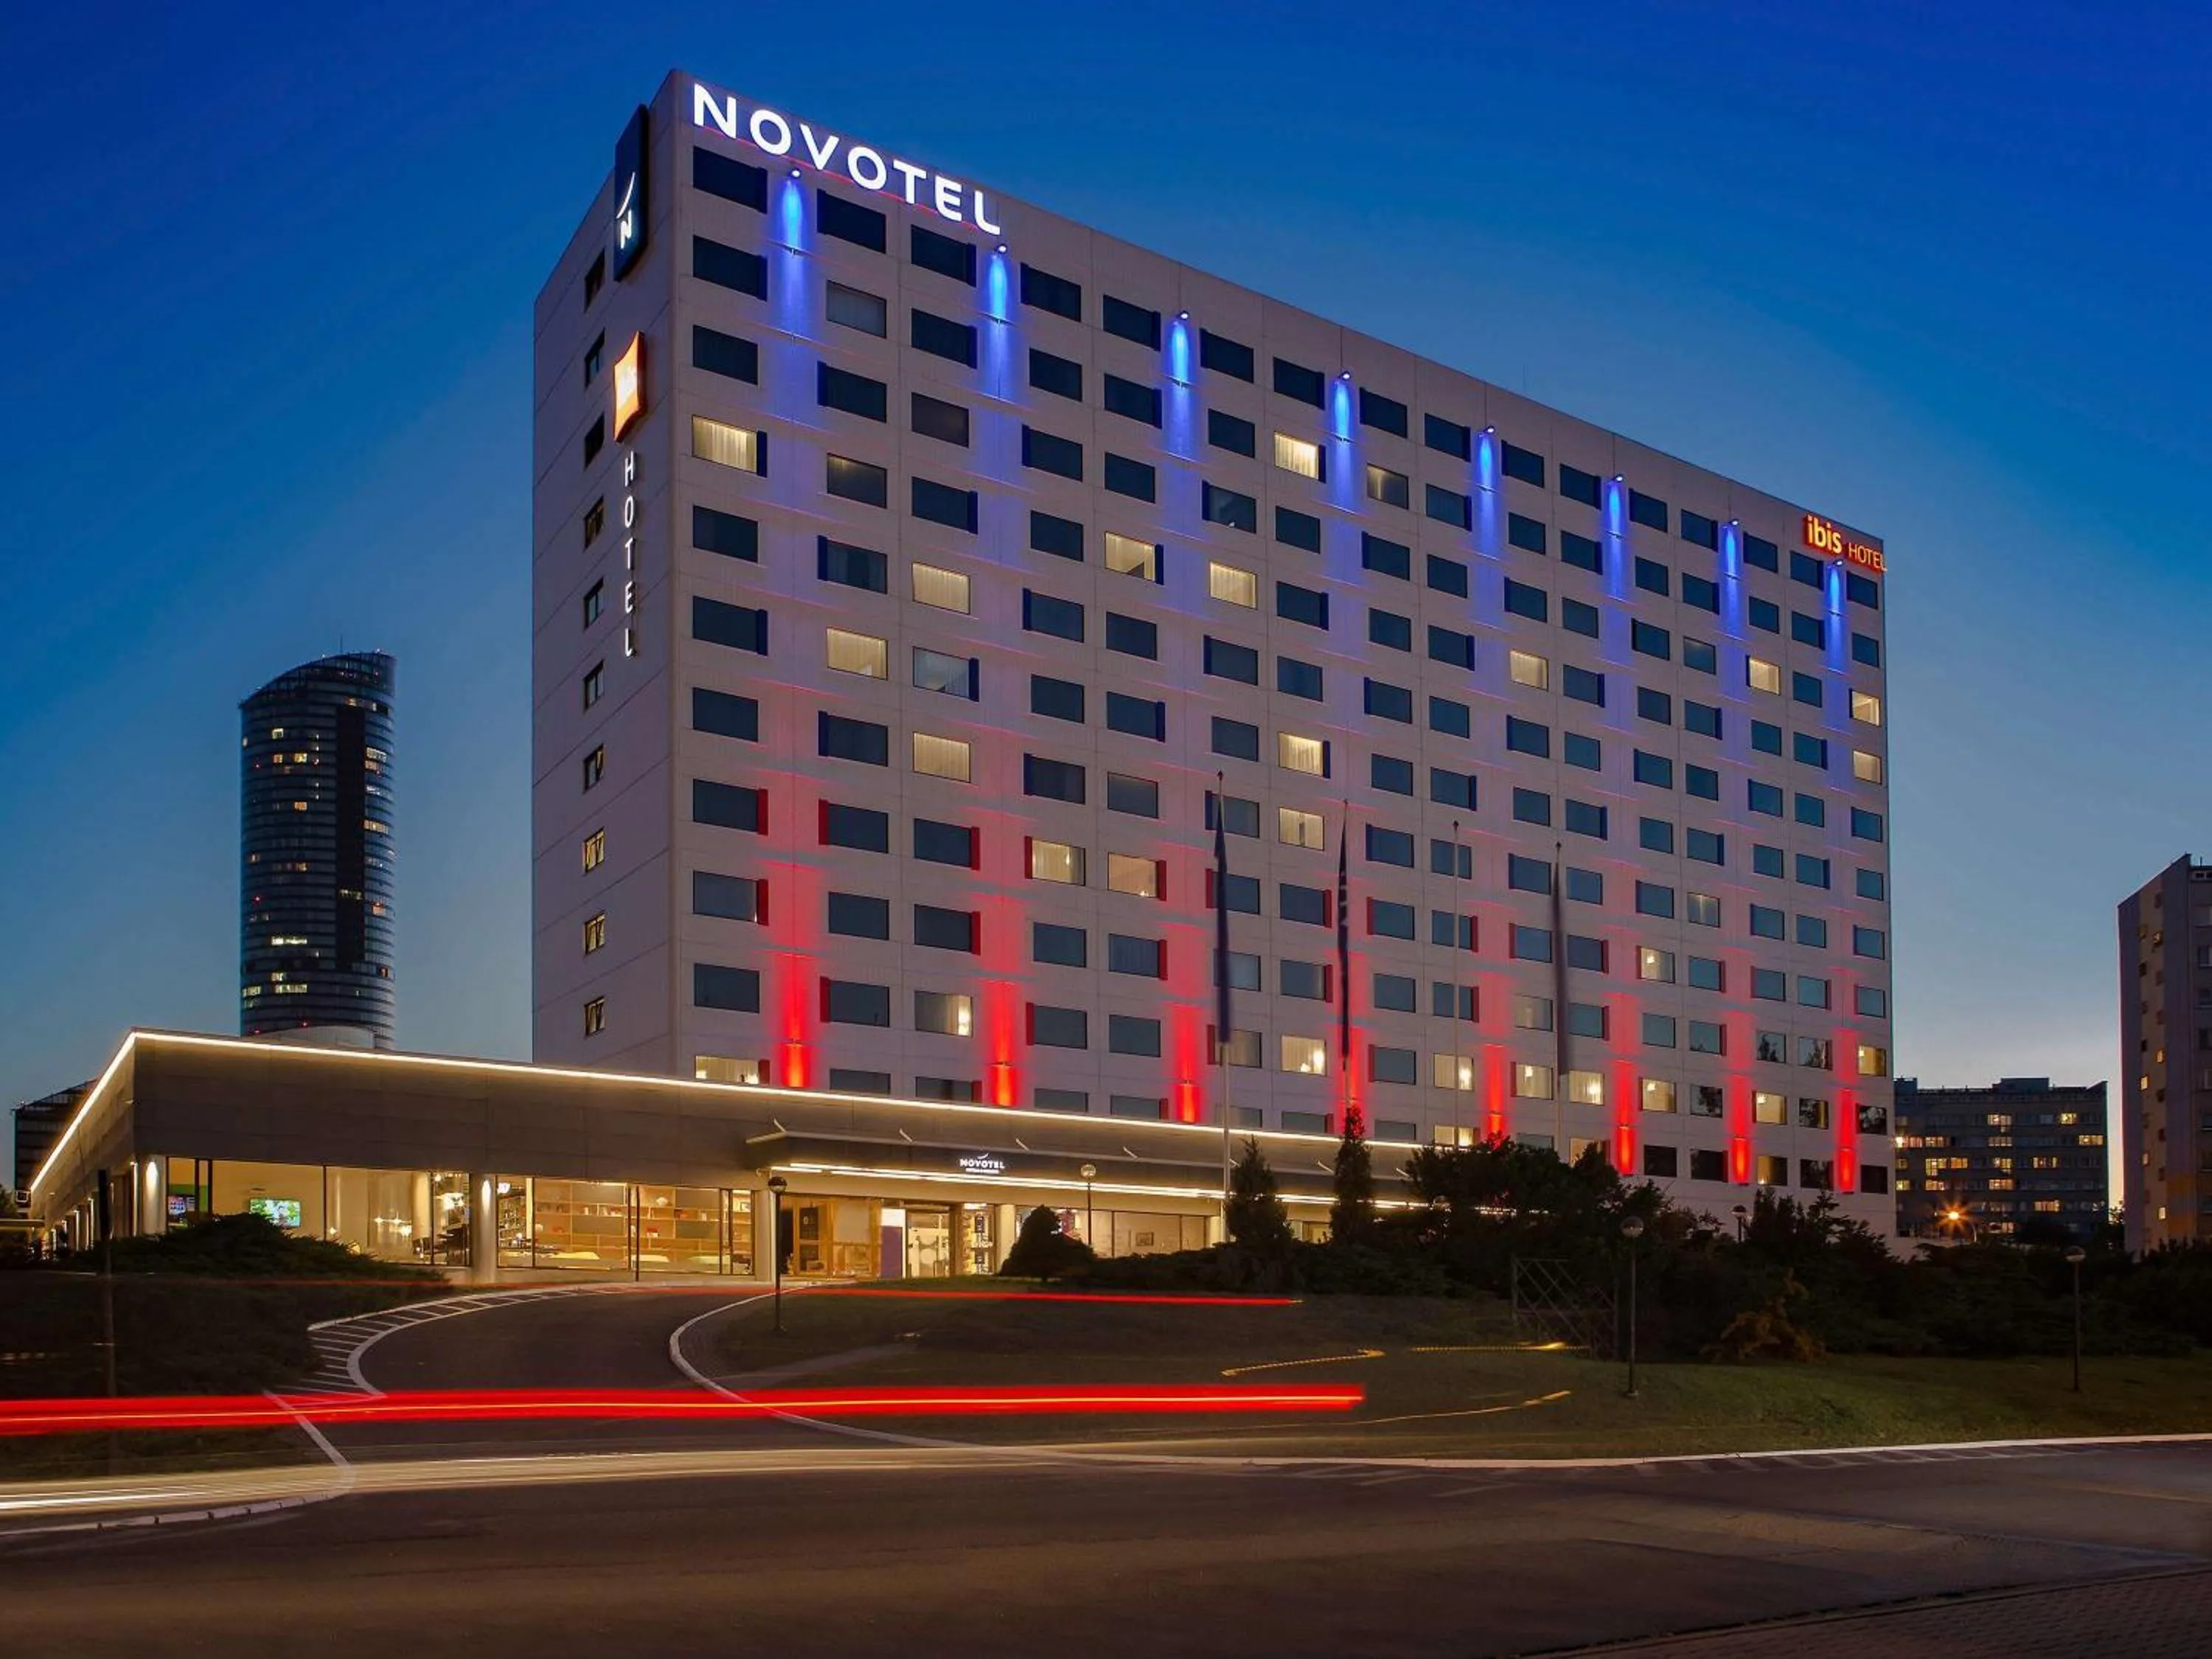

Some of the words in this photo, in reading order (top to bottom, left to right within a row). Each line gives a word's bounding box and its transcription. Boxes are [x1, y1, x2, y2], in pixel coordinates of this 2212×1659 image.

[693, 83, 1001, 234] NOVOTEL
[625, 451, 635, 656] HOTEL
[1807, 515, 1843, 554] ibis
[1848, 542, 1888, 571] HOTEL
[959, 1158, 1005, 1169] NOVOTEL
